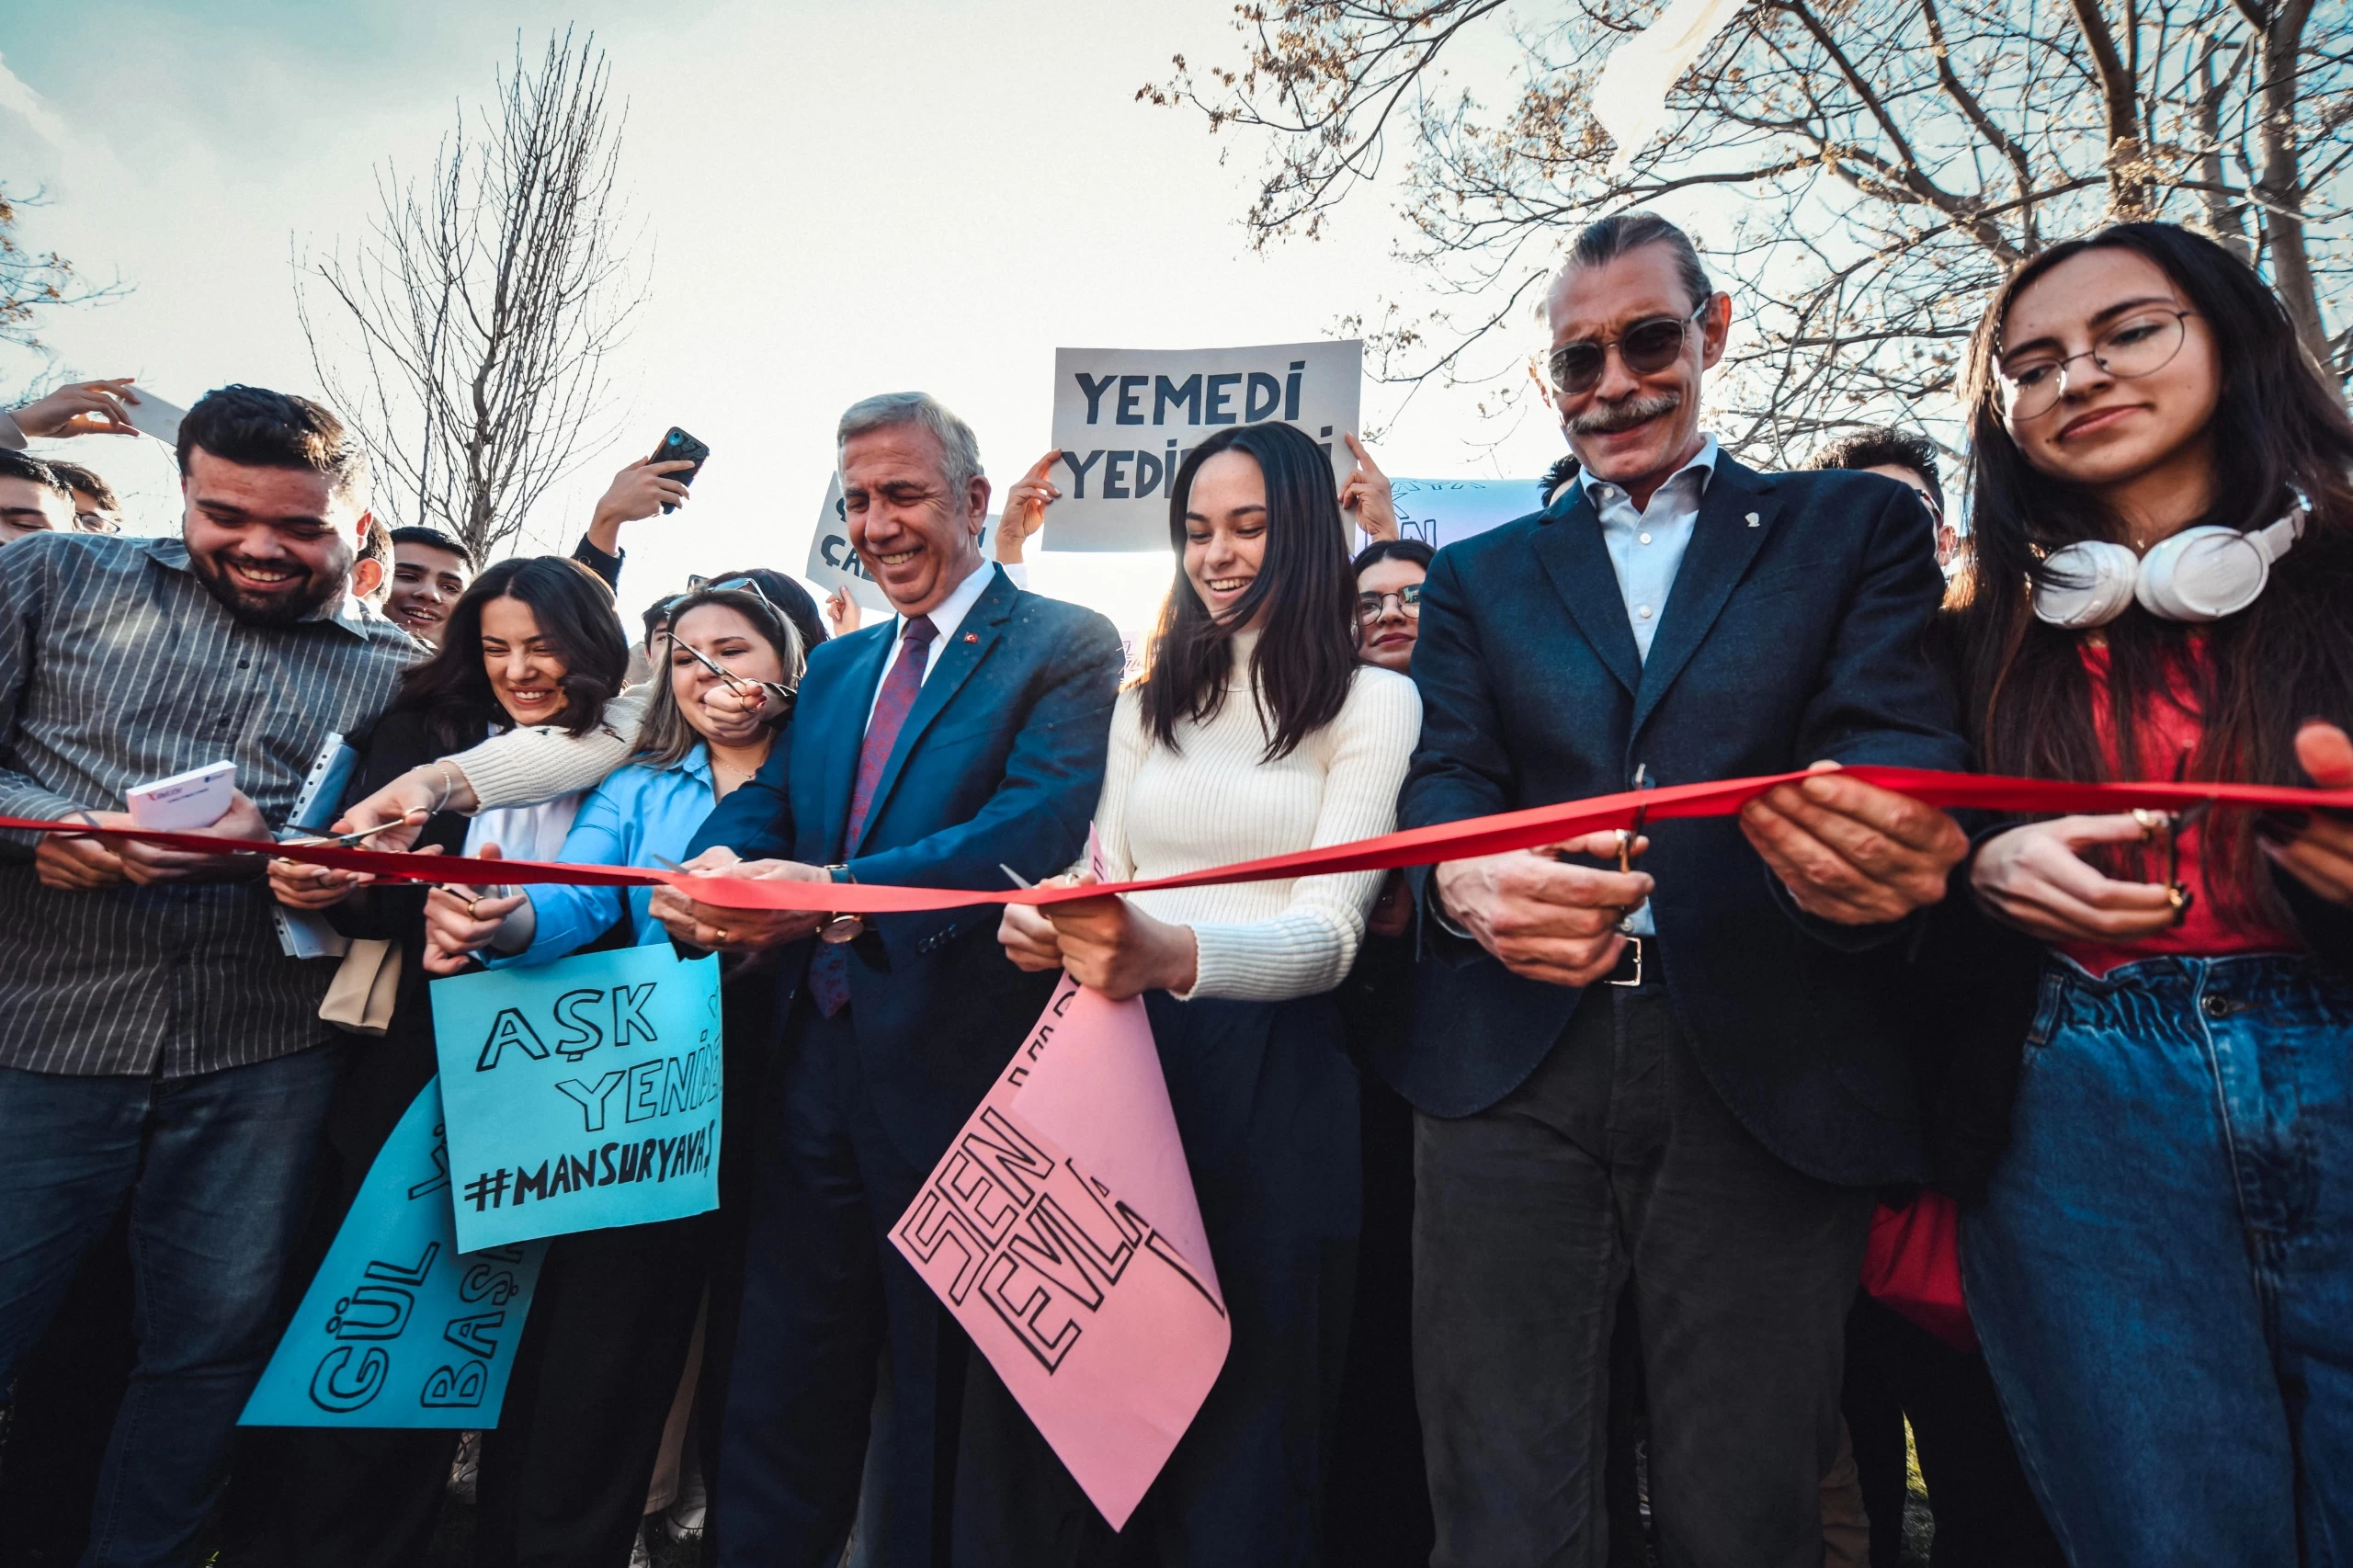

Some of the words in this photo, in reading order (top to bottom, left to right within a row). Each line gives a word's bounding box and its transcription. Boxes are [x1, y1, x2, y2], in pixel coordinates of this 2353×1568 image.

[1074, 359, 1306, 426] YEMEDİ
[475, 982, 658, 1073] AŞK
[555, 1028, 722, 1133] YENİDE
[463, 1118, 716, 1213] #MANSURYAVAŞ
[899, 1105, 1055, 1307] SEN
[307, 1240, 441, 1415] GÜL
